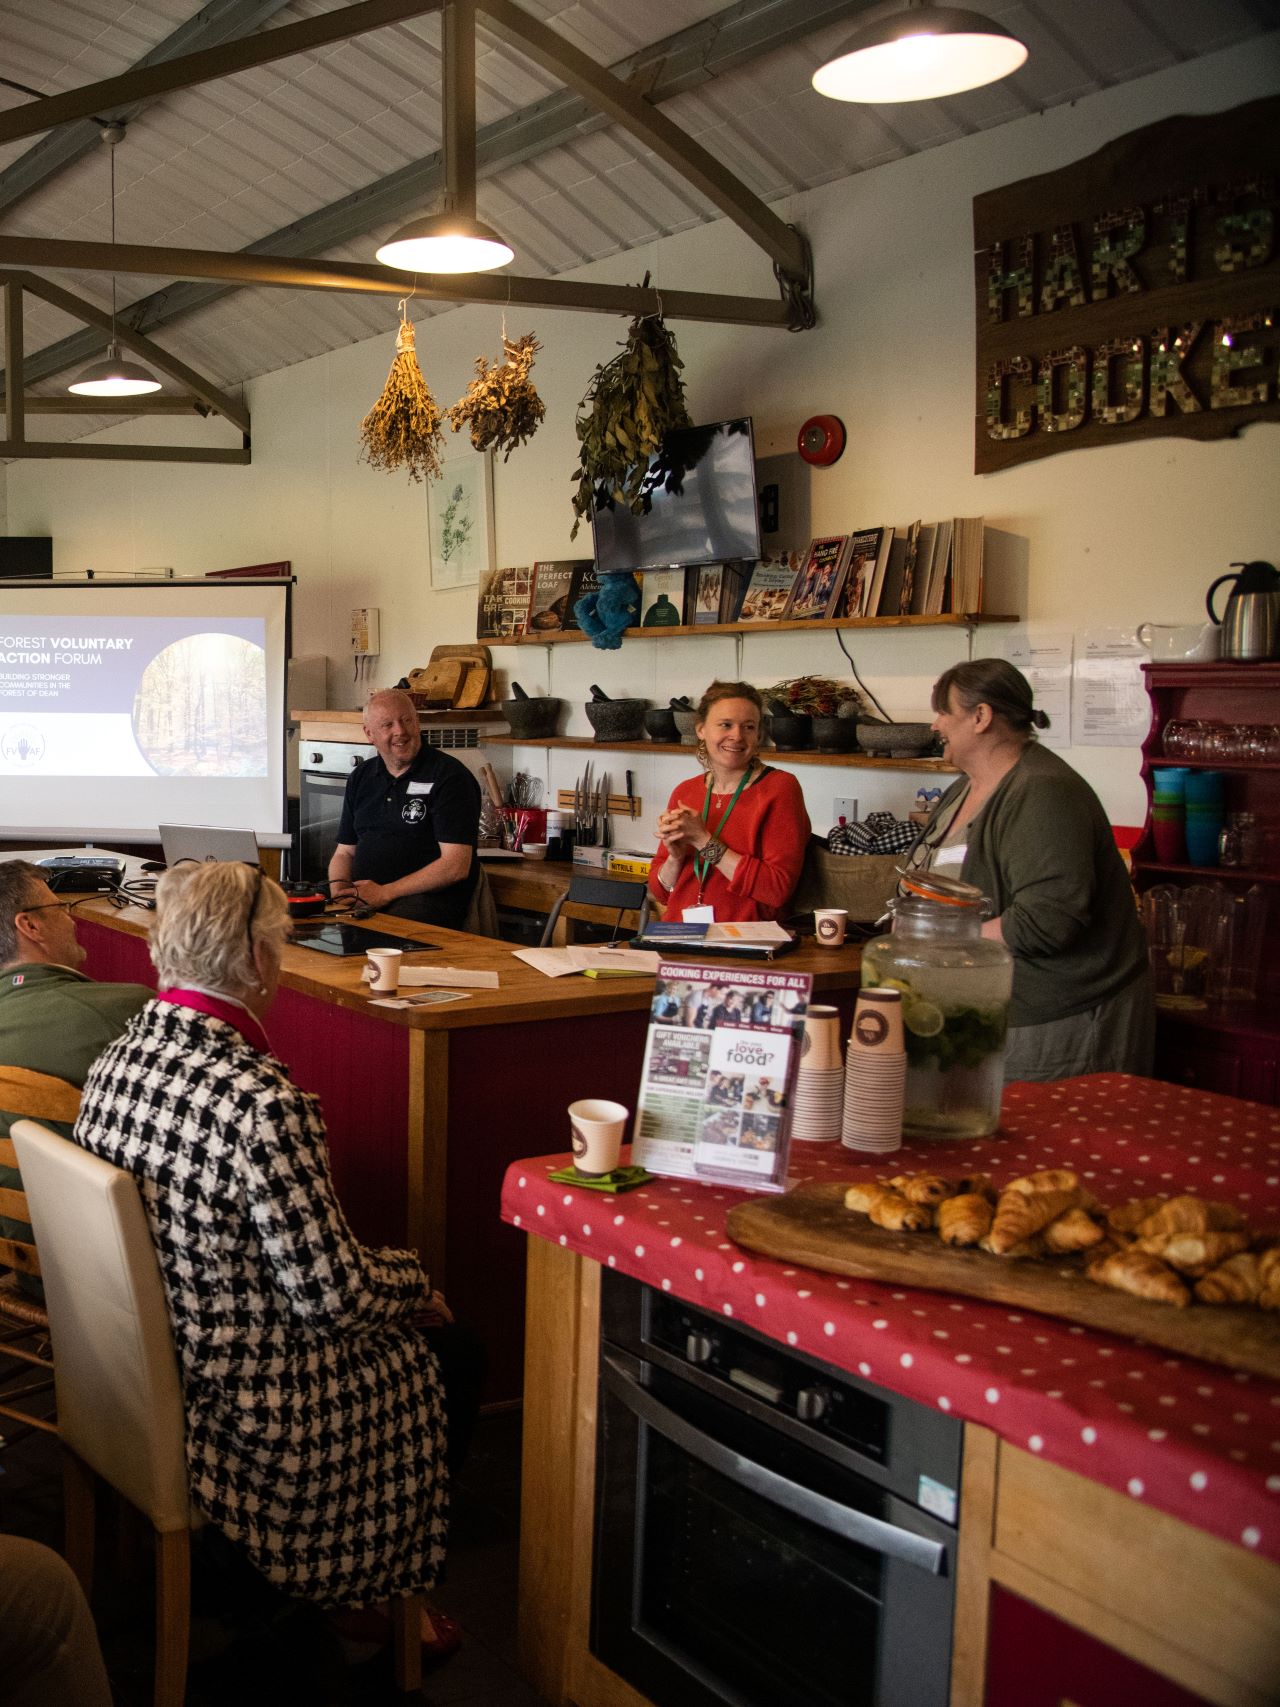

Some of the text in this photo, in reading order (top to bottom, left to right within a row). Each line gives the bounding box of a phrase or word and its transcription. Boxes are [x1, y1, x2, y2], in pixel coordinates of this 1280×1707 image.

[985, 311, 1280, 440] COOKE
[538, 564, 554, 572] THE
[538, 572, 573, 580] PERFECT
[537, 581, 559, 589] LOAF
[483, 595, 503, 603] TAR
[483, 603, 503, 612] BRE
[50, 637, 134, 650] VOLUNTARY
[54, 653, 103, 665] FORUM
[31, 673, 71, 681] STRONGER
[611, 863, 649, 875] NITRILE XL
[660, 966, 806, 988] COOKING EXPERIENCES FOR ALL
[736, 1043, 763, 1054] love
[727, 1049, 774, 1066] food?
